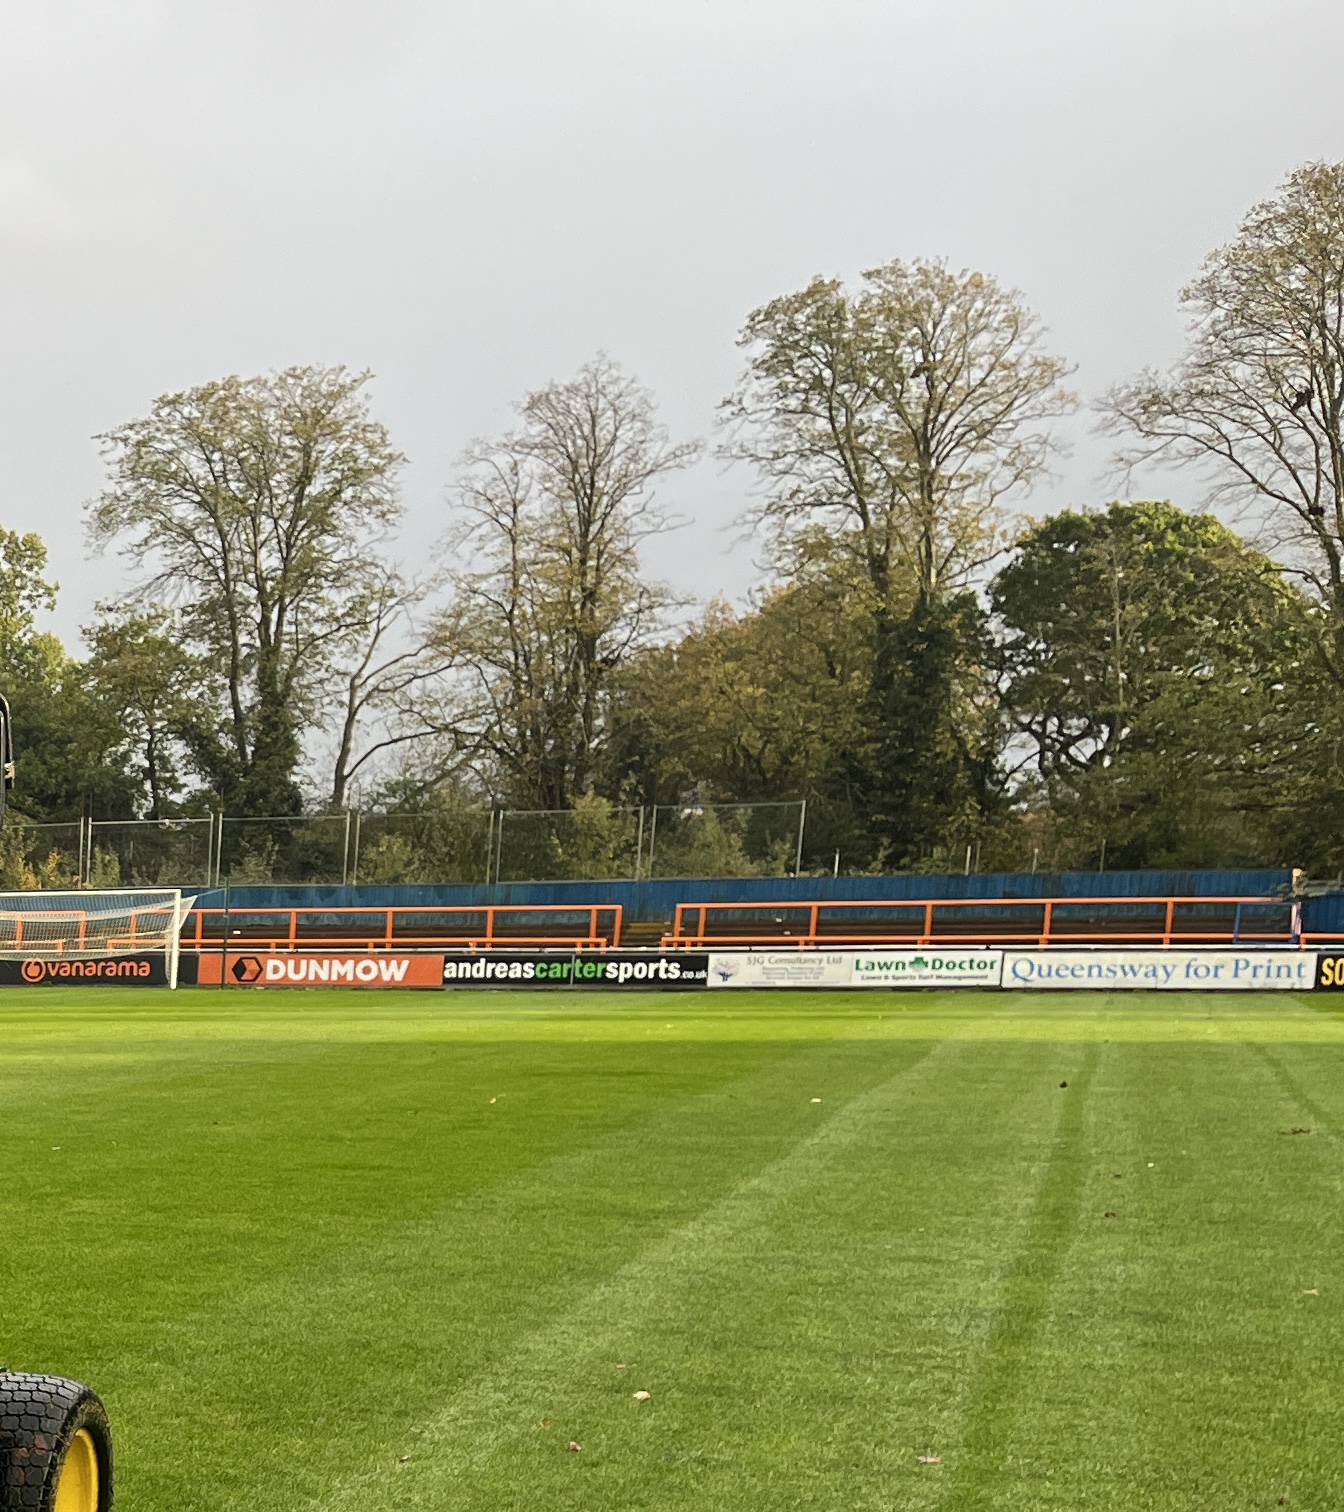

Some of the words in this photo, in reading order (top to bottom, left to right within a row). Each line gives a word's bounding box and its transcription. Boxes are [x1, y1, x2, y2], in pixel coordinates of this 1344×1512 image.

[47, 960, 150, 976] vanarama
[266, 959, 410, 981] DUNMOW
[444, 957, 707, 983] andreascartersports.co.uk
[768, 955, 823, 966] Consultancy
[826, 956, 842, 964] Ltd
[855, 959, 905, 971] Lawn
[932, 958, 997, 970] Doctor
[1012, 957, 1176, 984] Queensway
[1184, 958, 1222, 979] for
[1233, 958, 1306, 979] Print
[1321, 957, 1344, 986] SO
